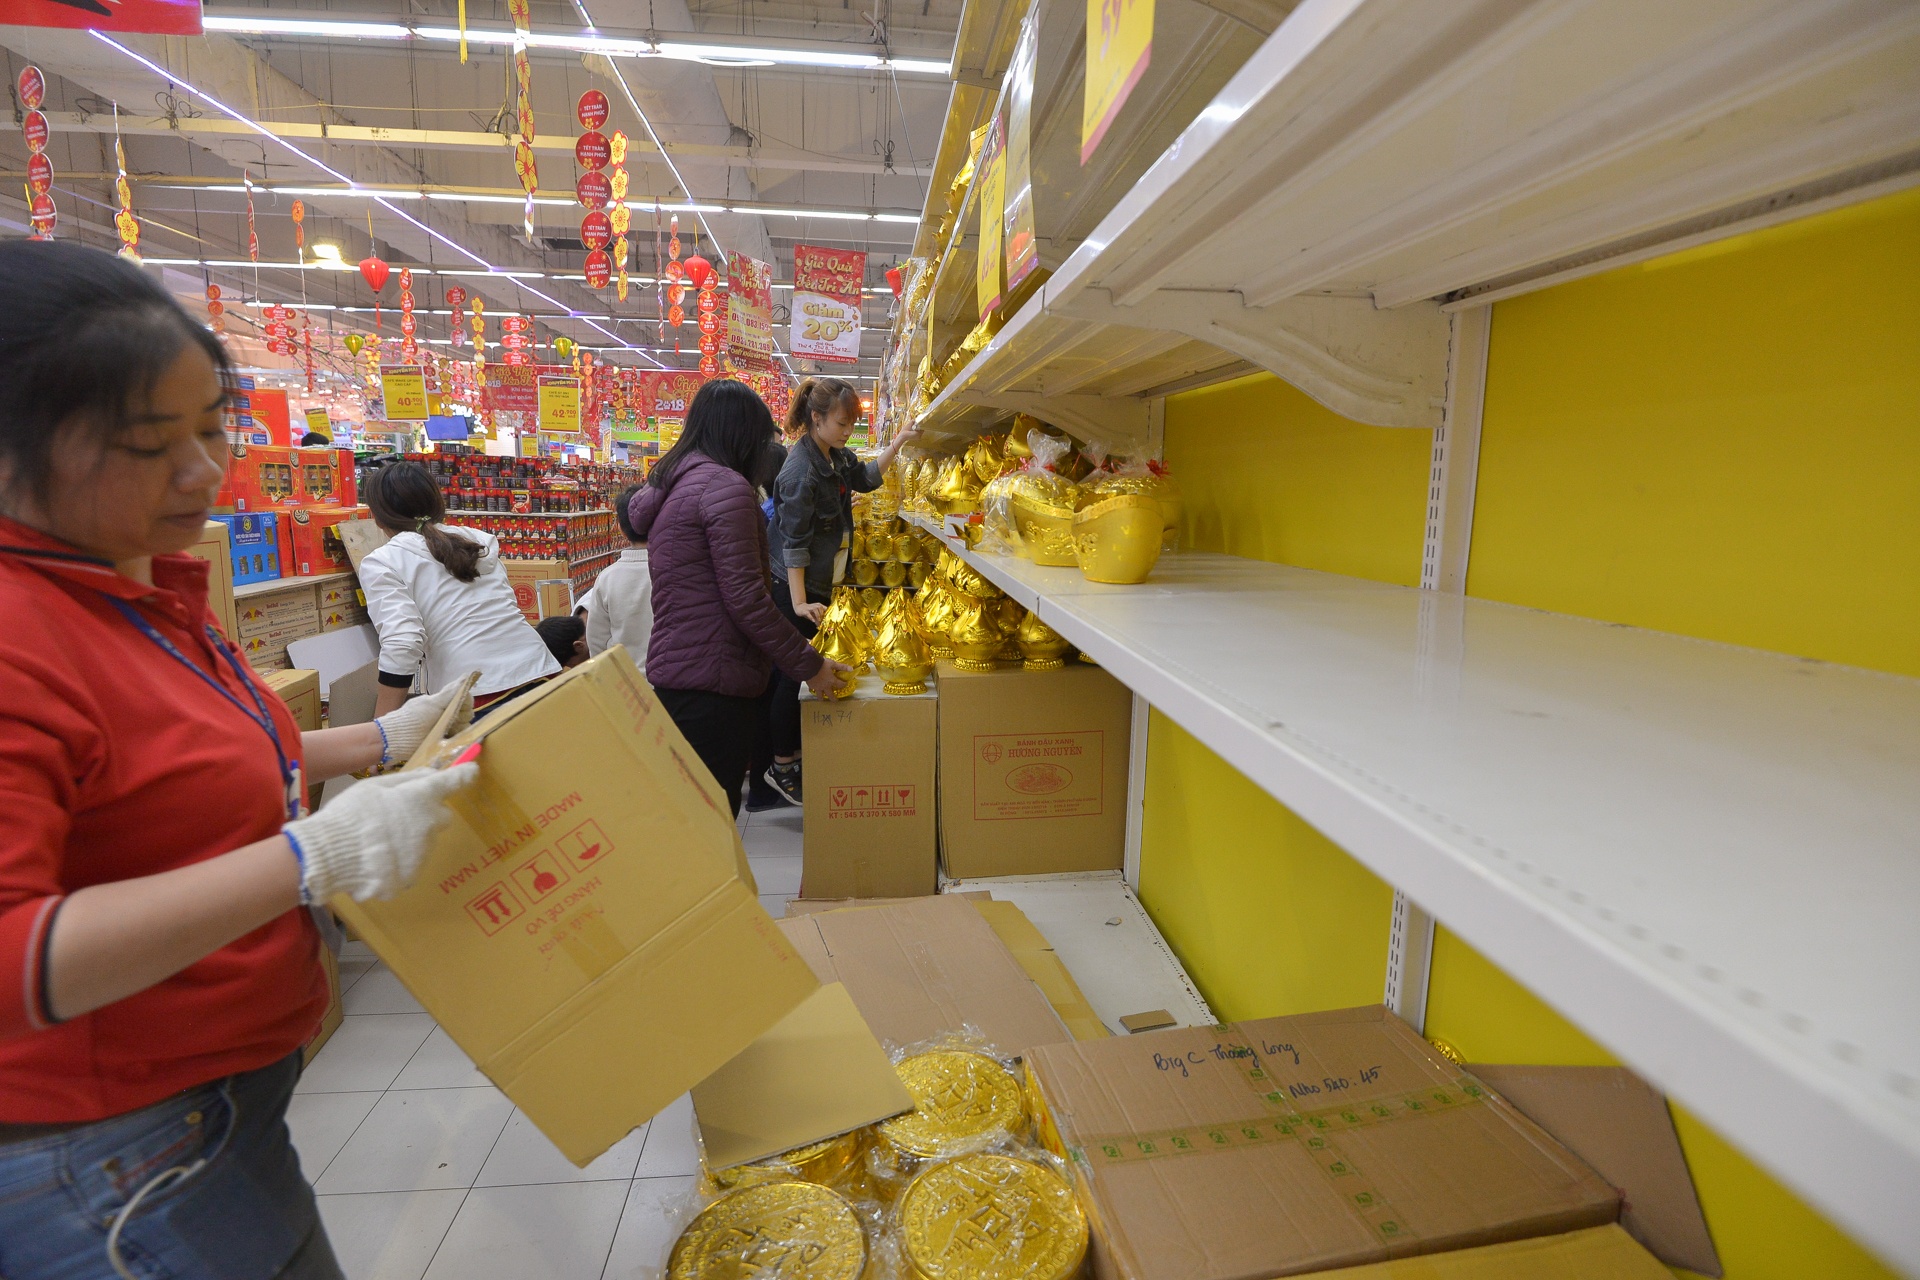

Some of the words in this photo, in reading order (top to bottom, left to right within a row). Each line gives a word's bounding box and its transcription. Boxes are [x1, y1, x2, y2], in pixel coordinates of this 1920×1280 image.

[804, 254, 824, 273] Giỏ
[827, 256, 853, 275] Quà
[818, 277, 837, 293] Tri
[803, 302, 845, 319] Giảm
[802, 318, 853, 342] 20%
[1008, 747, 1041, 758] HƯƠNG
[1017, 739, 1037, 747] BÁNH
[534, 791, 584, 829] MADE
[903, 809, 916, 817] MM
[515, 822, 536, 844] IN
[482, 834, 515, 869] VIET
[438, 862, 480, 895] NAM
[1153, 1052, 1189, 1078] Big
[1187, 1052, 1206, 1064] C
[1360, 1065, 1382, 1084] 45
